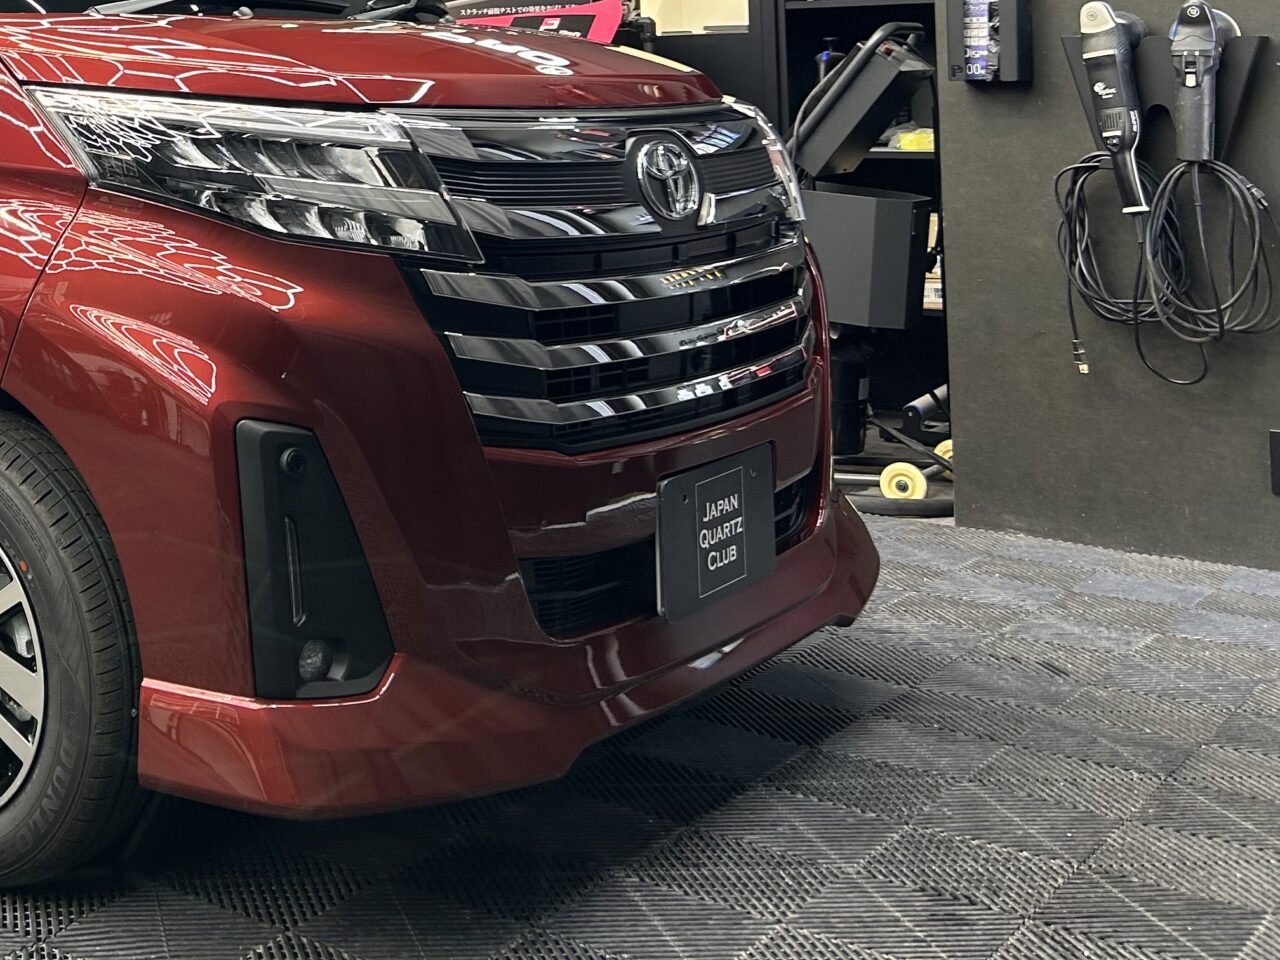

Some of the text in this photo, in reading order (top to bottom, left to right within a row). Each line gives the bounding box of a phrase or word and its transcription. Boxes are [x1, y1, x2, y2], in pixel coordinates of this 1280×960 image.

[703, 493, 739, 522] JAPAN
[699, 516, 743, 549] QUARTZ
[707, 545, 737, 571] CLUB
